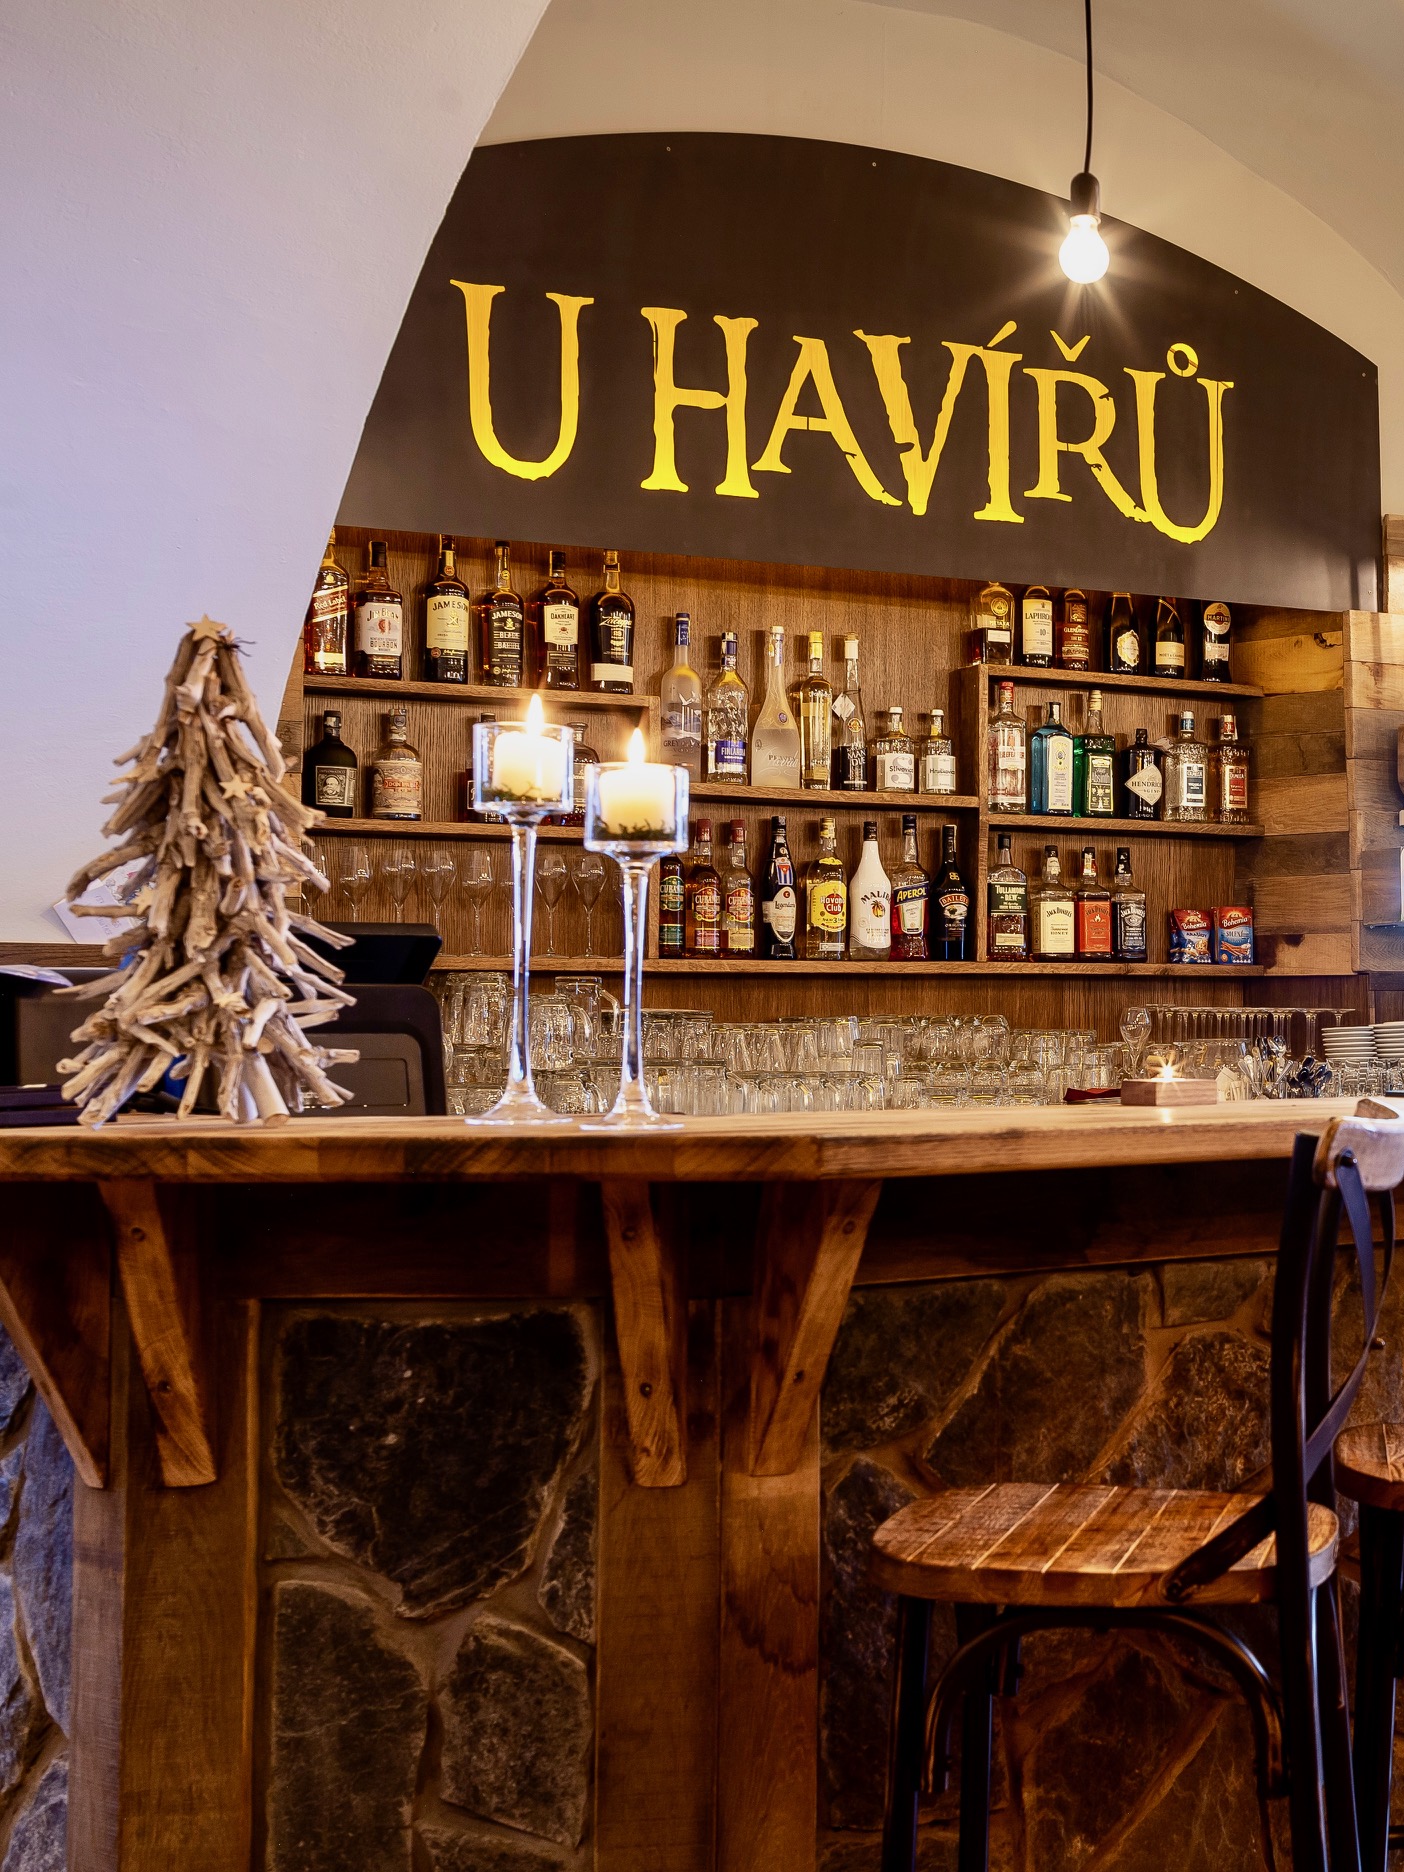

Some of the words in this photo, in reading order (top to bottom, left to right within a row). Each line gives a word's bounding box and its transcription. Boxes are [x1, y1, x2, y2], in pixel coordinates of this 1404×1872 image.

[449, 279, 594, 481] U
[640, 306, 1235, 544] HAVÍŘŮ
[314, 600, 328, 610] Red
[328, 596, 346, 608] Label
[432, 600, 468, 612] JAMESON
[492, 610, 522, 620] JAMESON
[370, 640, 398, 648] BOURBON
[896, 886, 927, 902] APEROL
[995, 885, 1025, 894] TULLAMORE
[826, 904, 842, 912] Club
[1046, 910, 1056, 918] JACK
[1181, 922, 1207, 930] Bohemia
[1222, 917, 1248, 928] Bohemia
